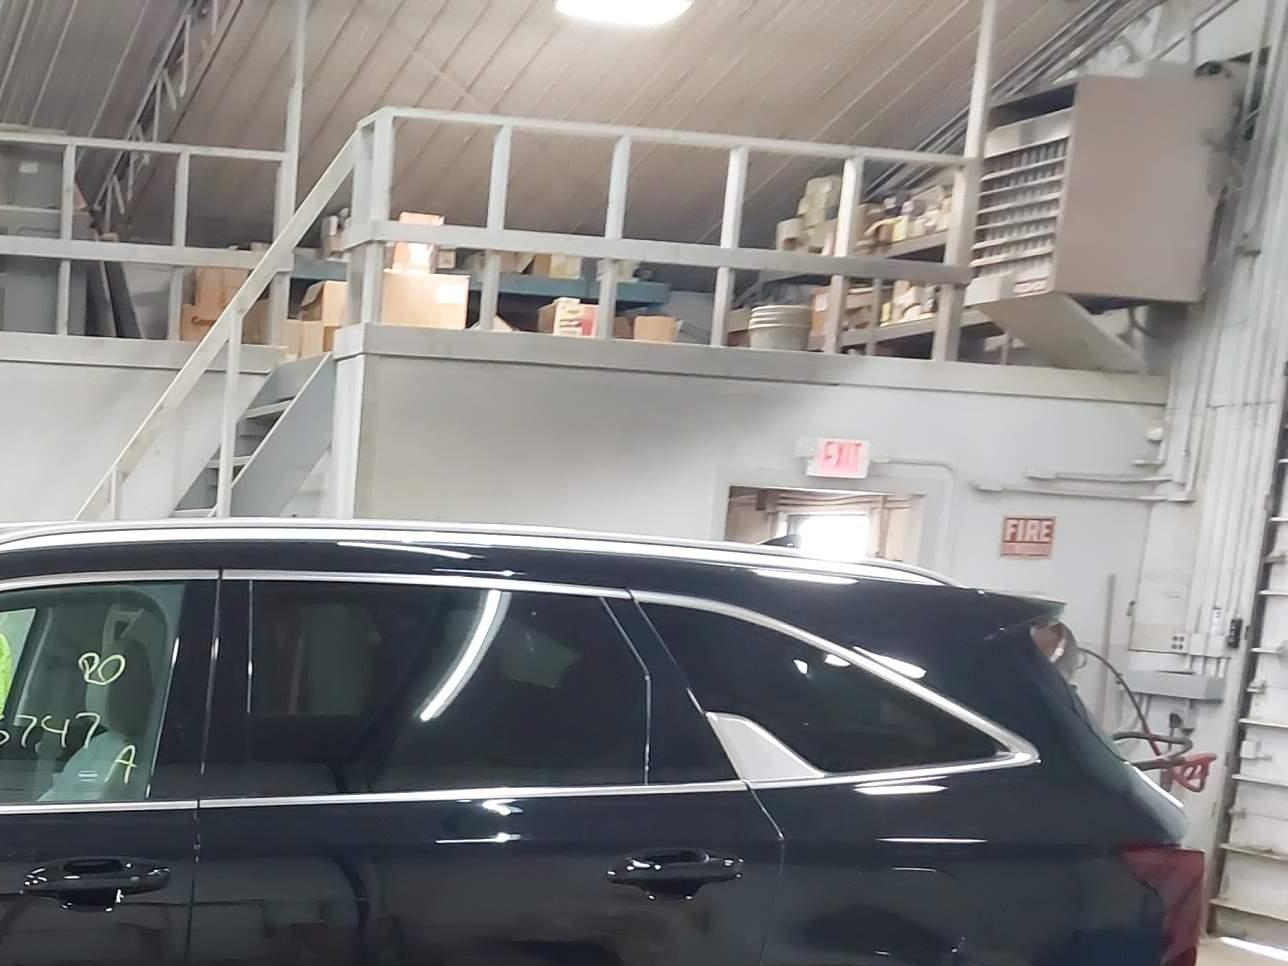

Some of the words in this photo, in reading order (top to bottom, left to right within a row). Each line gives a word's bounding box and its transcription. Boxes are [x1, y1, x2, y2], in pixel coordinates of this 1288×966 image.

[822, 441, 863, 470] EXIT
[1005, 519, 1053, 542] FIRE
[104, 744, 138, 784] A
